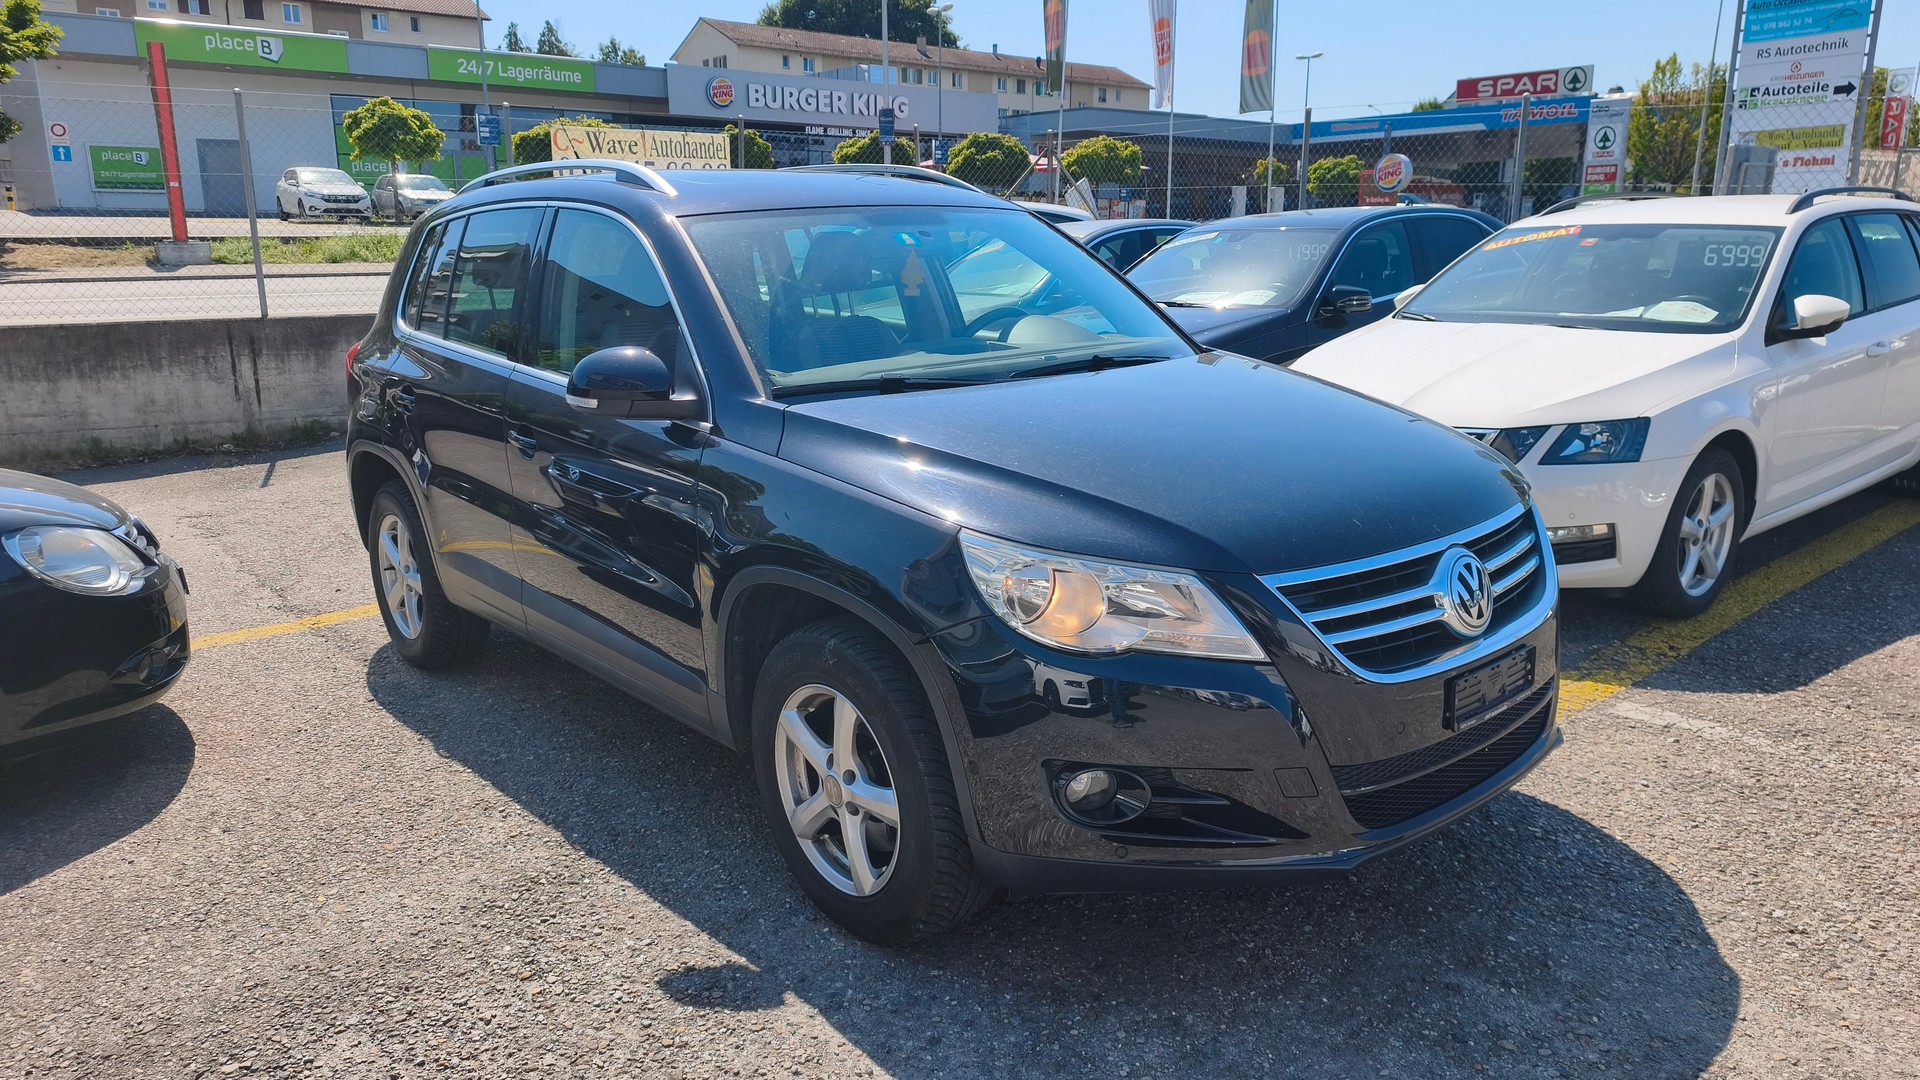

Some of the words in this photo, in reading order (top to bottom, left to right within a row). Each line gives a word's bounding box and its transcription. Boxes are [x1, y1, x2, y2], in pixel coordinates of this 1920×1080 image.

[204, 33, 254, 51] place
[1756, 48, 1771, 59] RS
[1774, 37, 1849, 58] Autotechnik
[457, 58, 494, 76] 24/7
[498, 62, 582, 84] Lagerräume
[711, 83, 733, 91] BURGER
[1477, 73, 1557, 97] SPAR
[1762, 81, 1830, 97] Autoteile
[712, 89, 733, 99] KING
[747, 83, 848, 115] BURGER
[852, 92, 909, 119] KING
[1760, 94, 1828, 106] Kreuzlingen
[1501, 103, 1578, 123] TAMOIL
[805, 126, 824, 135] FLAME
[827, 128, 853, 137] GRILLING
[1790, 126, 1844, 140] Autohandel
[650, 133, 727, 160] Autohandel
[1803, 139, 1841, 148] Verkauf
[101, 150, 132, 161] place
[1792, 155, 1835, 168] Flohmi
[351, 161, 387, 173] place
[1377, 168, 1402, 183] KING
[1484, 227, 1579, 249] AUTOMAT
